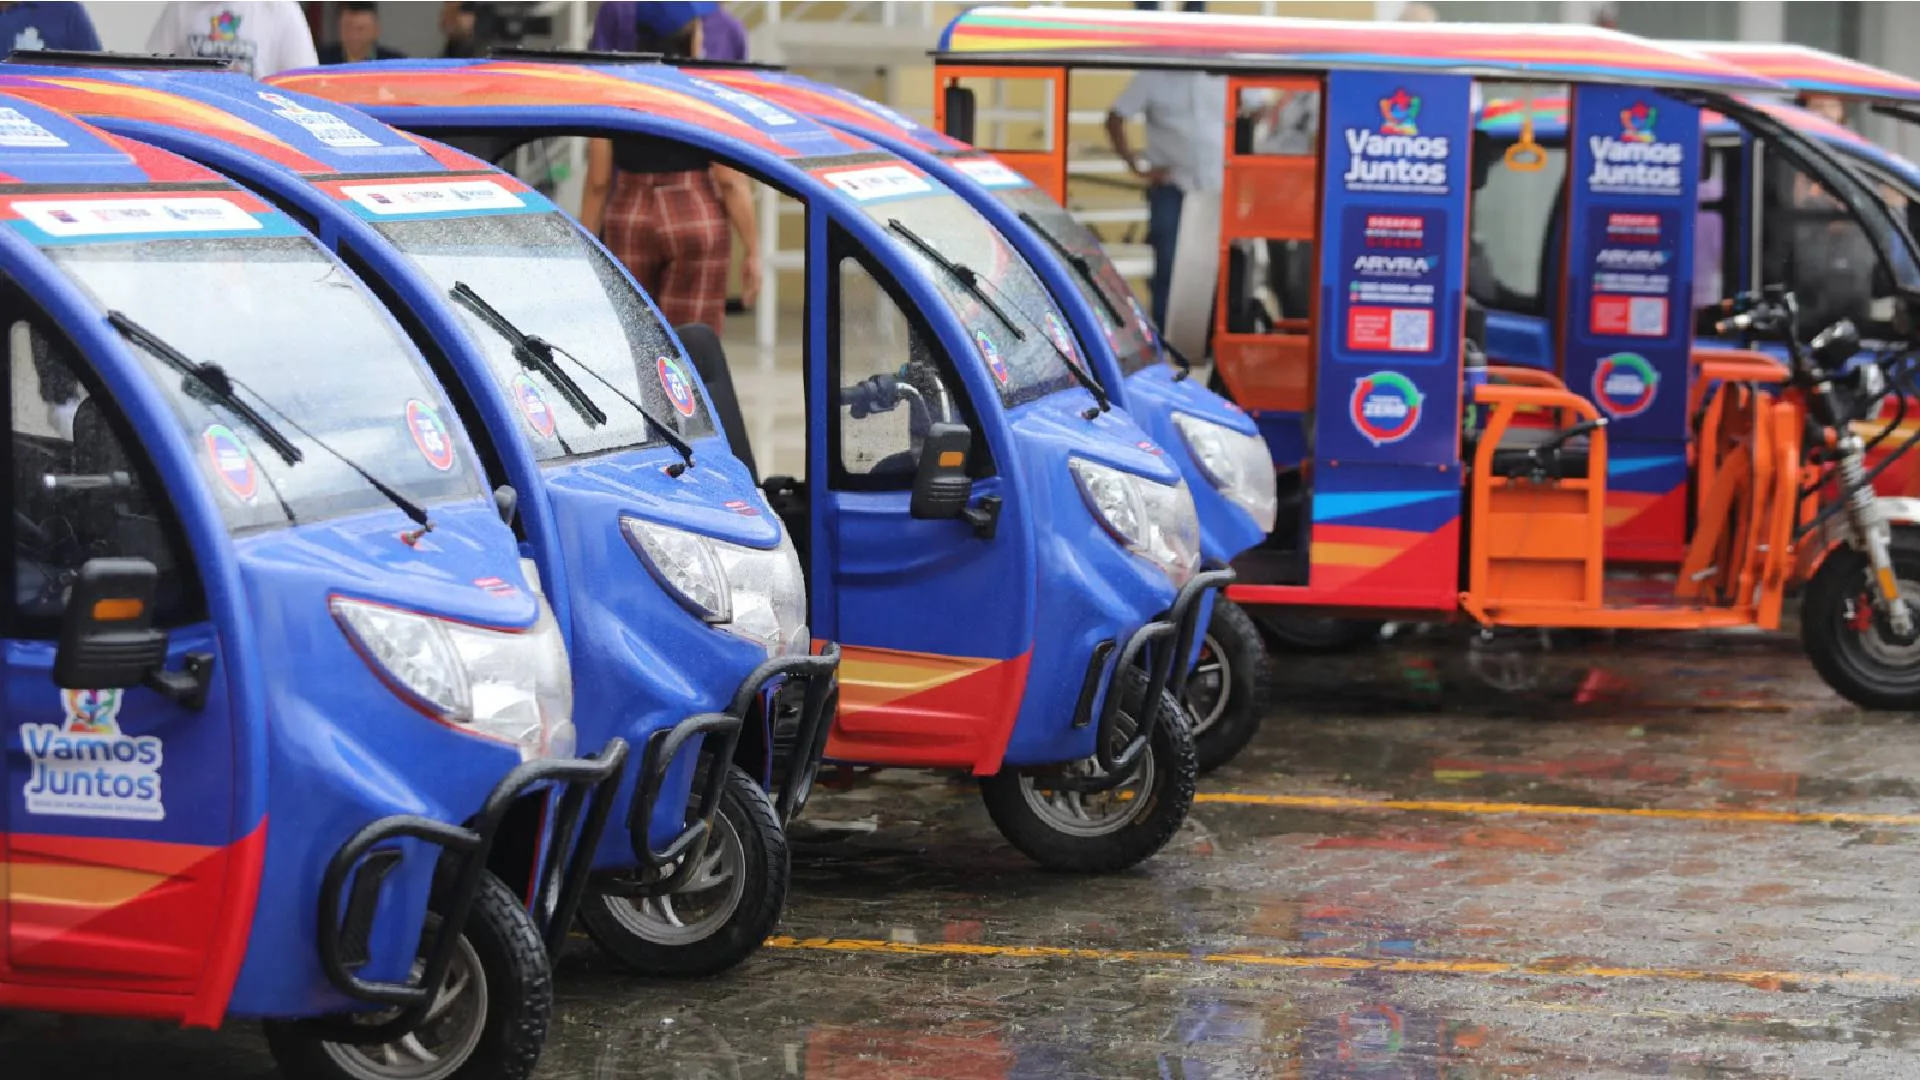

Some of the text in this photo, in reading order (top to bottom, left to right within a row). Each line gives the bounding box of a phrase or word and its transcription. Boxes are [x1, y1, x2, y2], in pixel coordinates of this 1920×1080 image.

[1345, 128, 1449, 159] Vamos
[1589, 135, 1682, 163] Vamos
[1344, 156, 1447, 184] Juntos
[1588, 162, 1681, 187] Juntos
[28, 728, 158, 765] Vamos
[30, 762, 156, 800] Juntos
